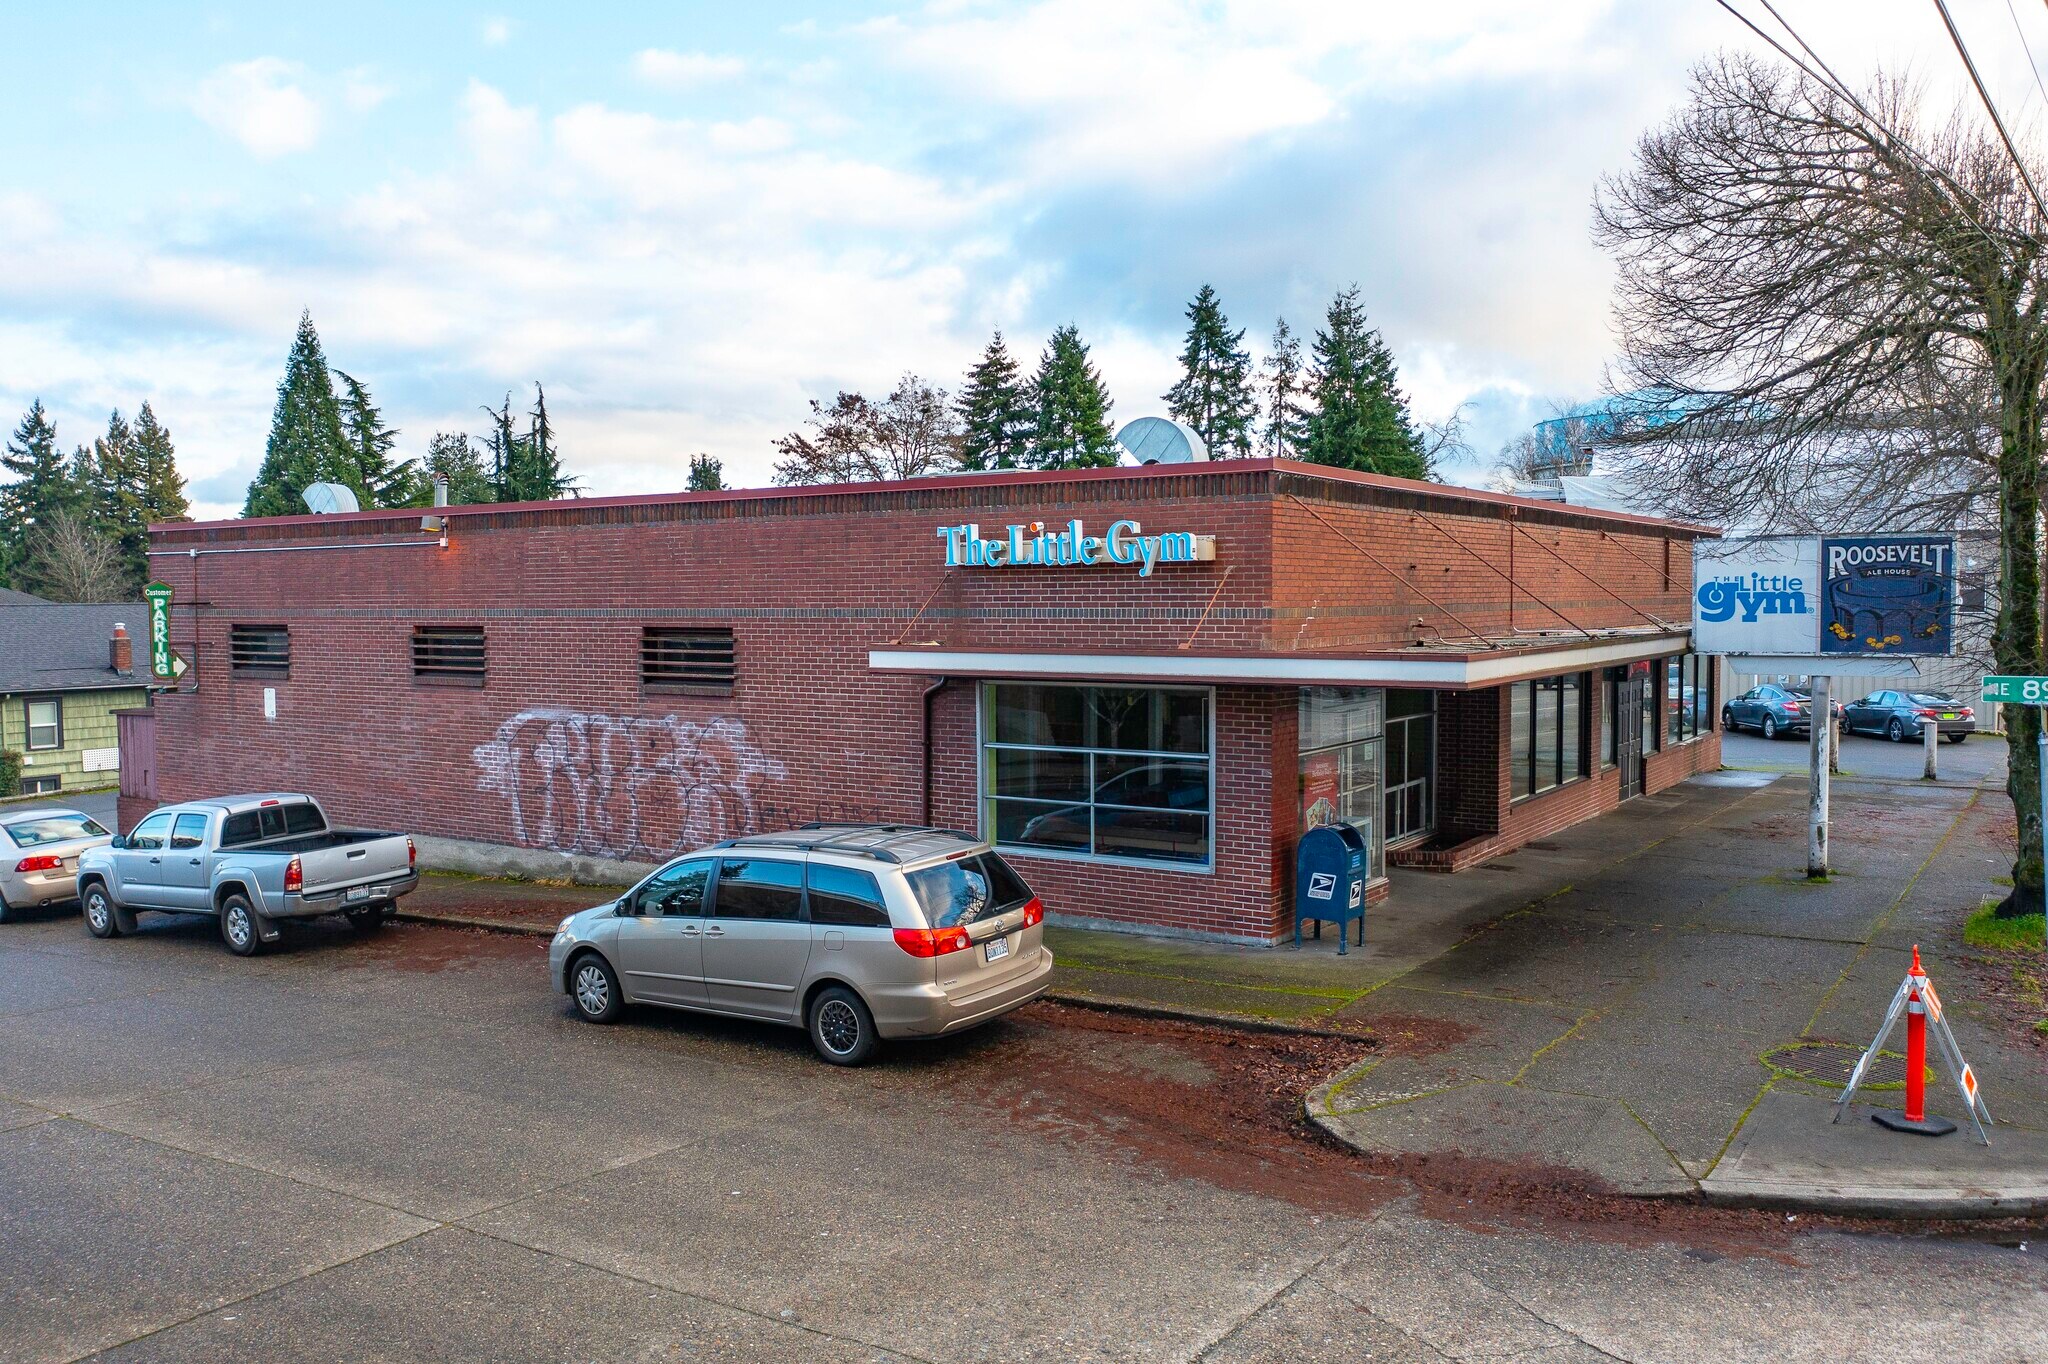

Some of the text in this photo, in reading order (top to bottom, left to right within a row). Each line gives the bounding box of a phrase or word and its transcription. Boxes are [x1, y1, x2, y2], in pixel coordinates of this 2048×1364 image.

[937, 519, 1197, 577] The Little Gym
[1827, 544, 1949, 580] ROOSEVELT
[1740, 572, 1802, 591] Little
[1866, 568, 1911, 576] ALE HOUSE
[145, 588, 172, 596] Customer
[1698, 582, 1807, 622] gym
[153, 598, 168, 675] PARKING
